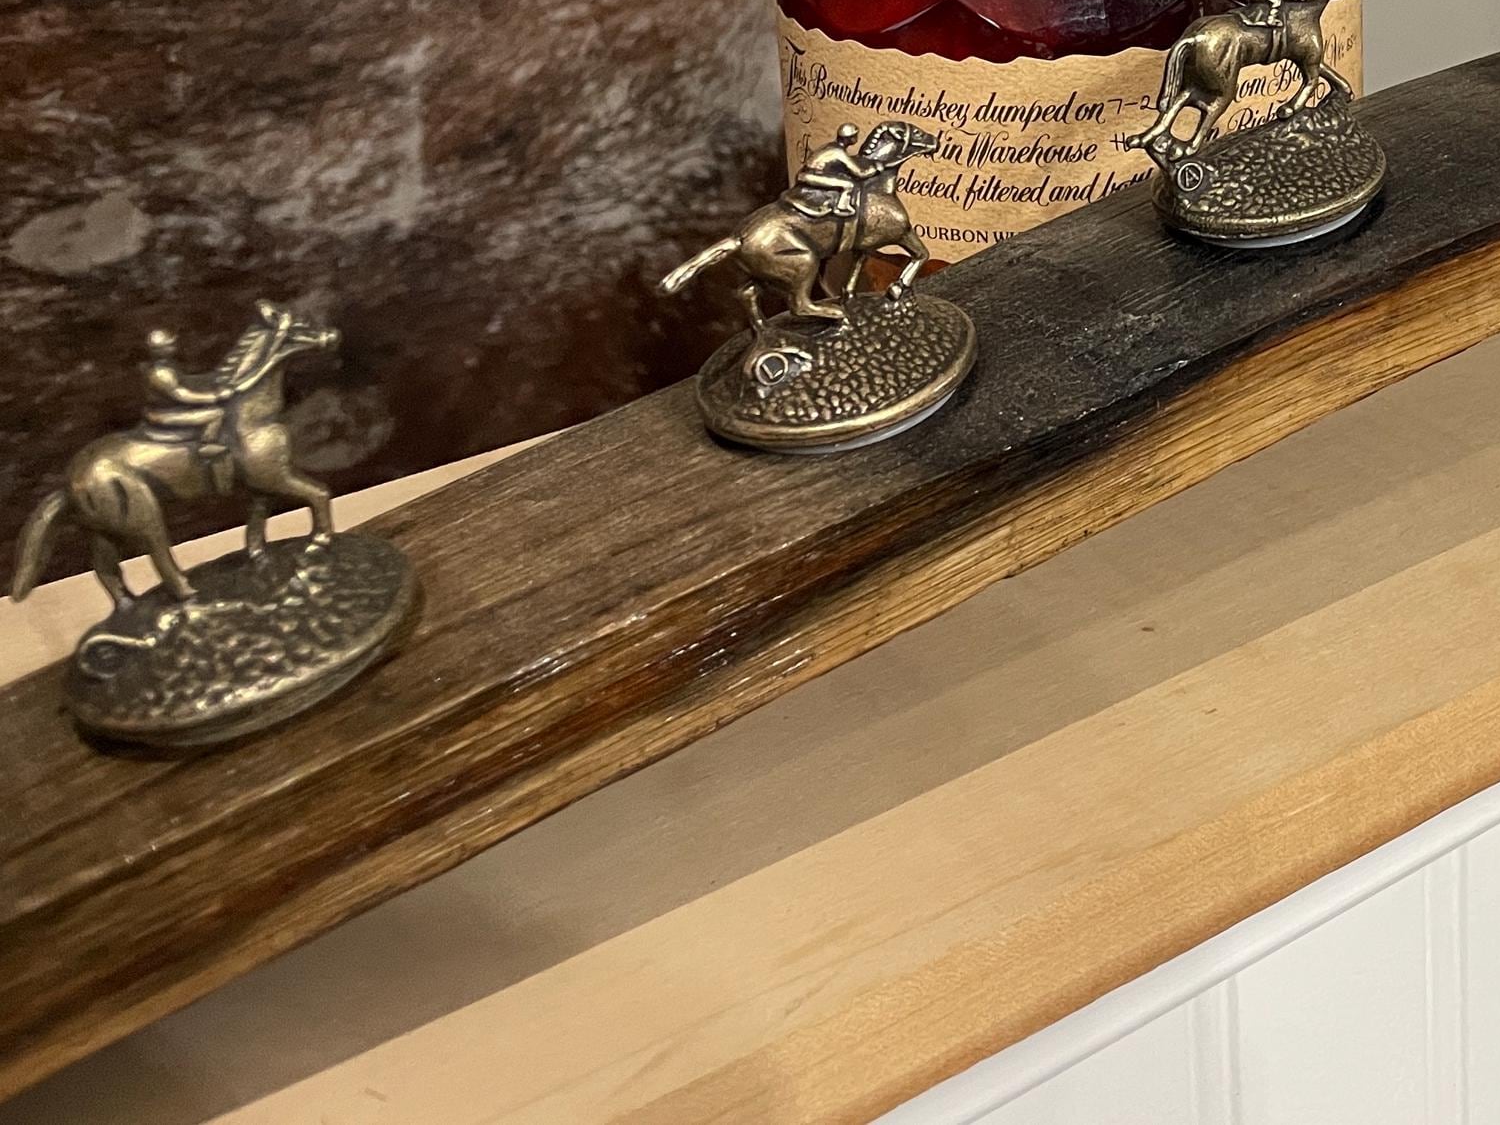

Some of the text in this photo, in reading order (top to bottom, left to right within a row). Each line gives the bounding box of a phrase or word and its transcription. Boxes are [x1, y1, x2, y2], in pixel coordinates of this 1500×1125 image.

[785, 36, 807, 99] This
[808, 63, 884, 115] Bourbon
[887, 87, 971, 128] whiskey
[972, 92, 1070, 132] dumped
[1074, 101, 1106, 124] on
[940, 136, 963, 166] in
[965, 131, 1098, 169] Warehouse
[896, 169, 961, 203] elected,
[962, 174, 1050, 211] filtered
[1049, 171, 1101, 204] and
[913, 223, 989, 244] OURBON
